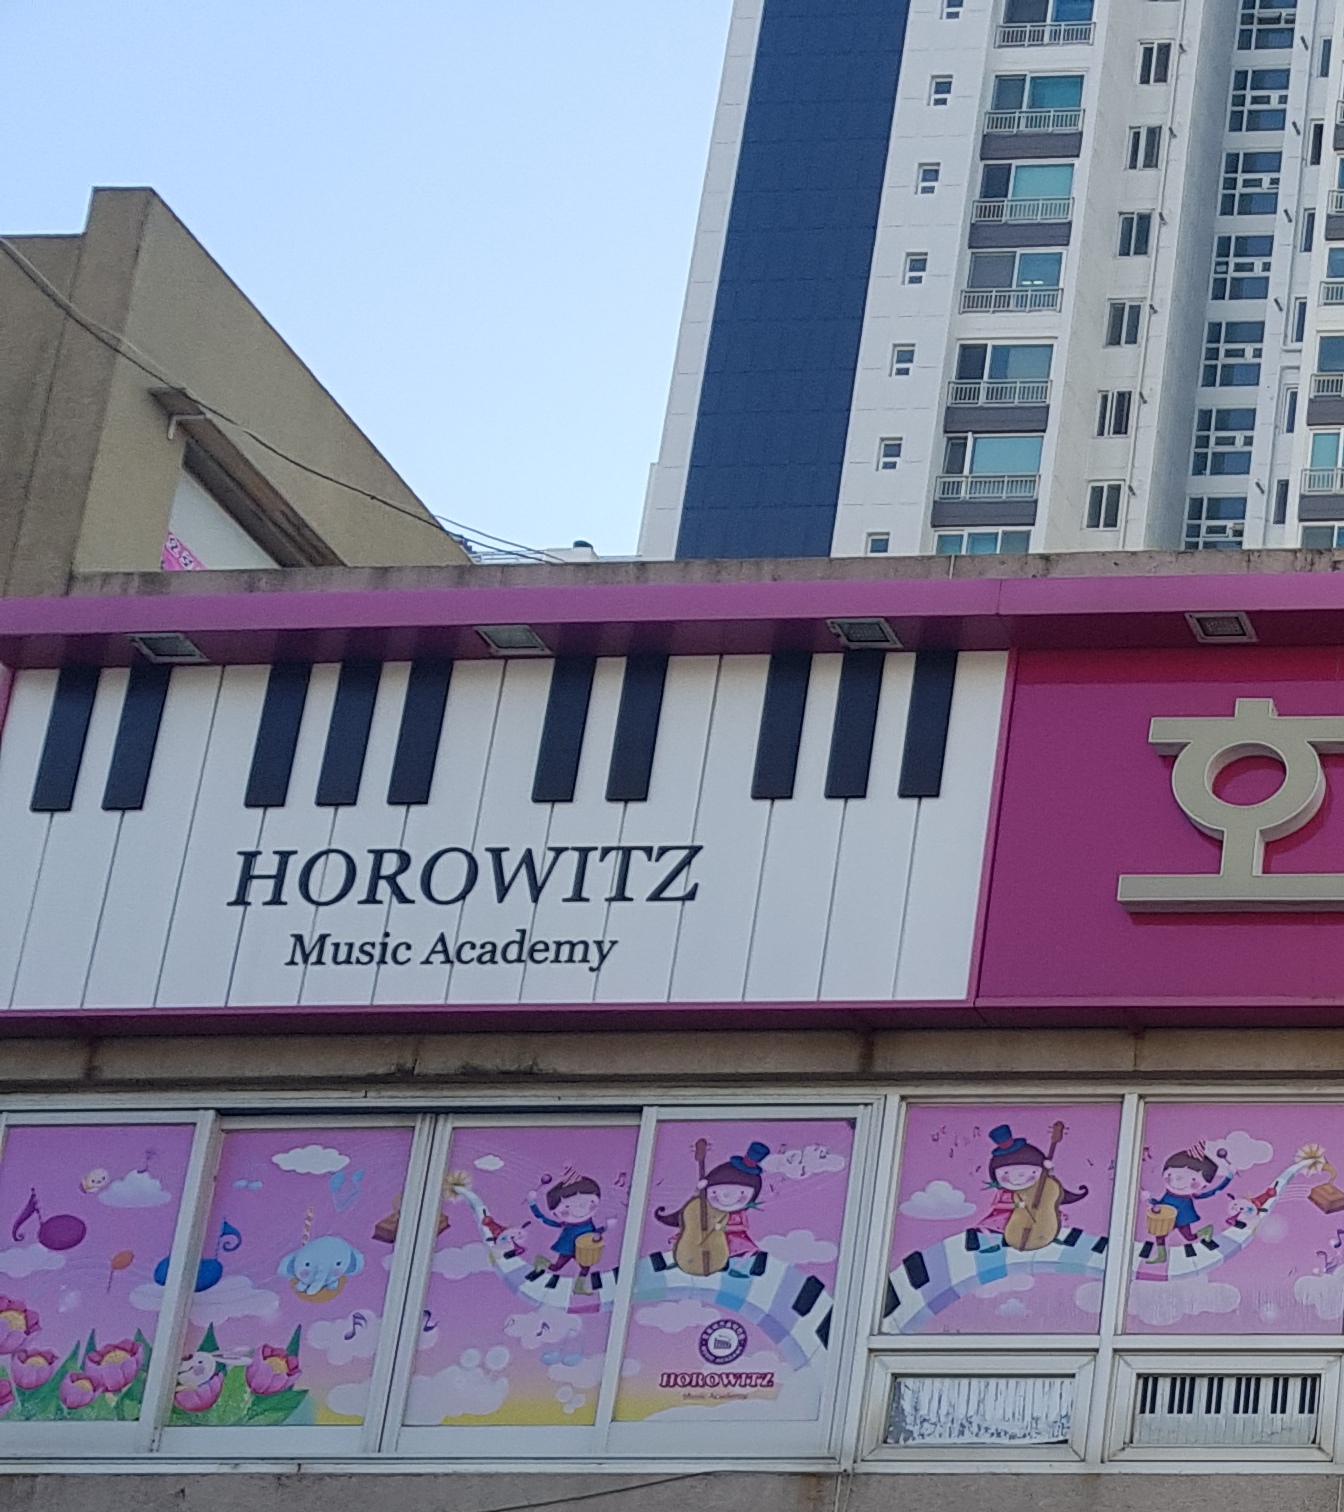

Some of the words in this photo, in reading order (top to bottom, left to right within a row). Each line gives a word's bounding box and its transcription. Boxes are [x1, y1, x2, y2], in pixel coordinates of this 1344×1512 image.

[227, 844, 704, 907] HOROWITZ
[284, 932, 413, 966] Music
[421, 929, 618, 971] Academy
[660, 1371, 775, 1388] HOROWITZ
